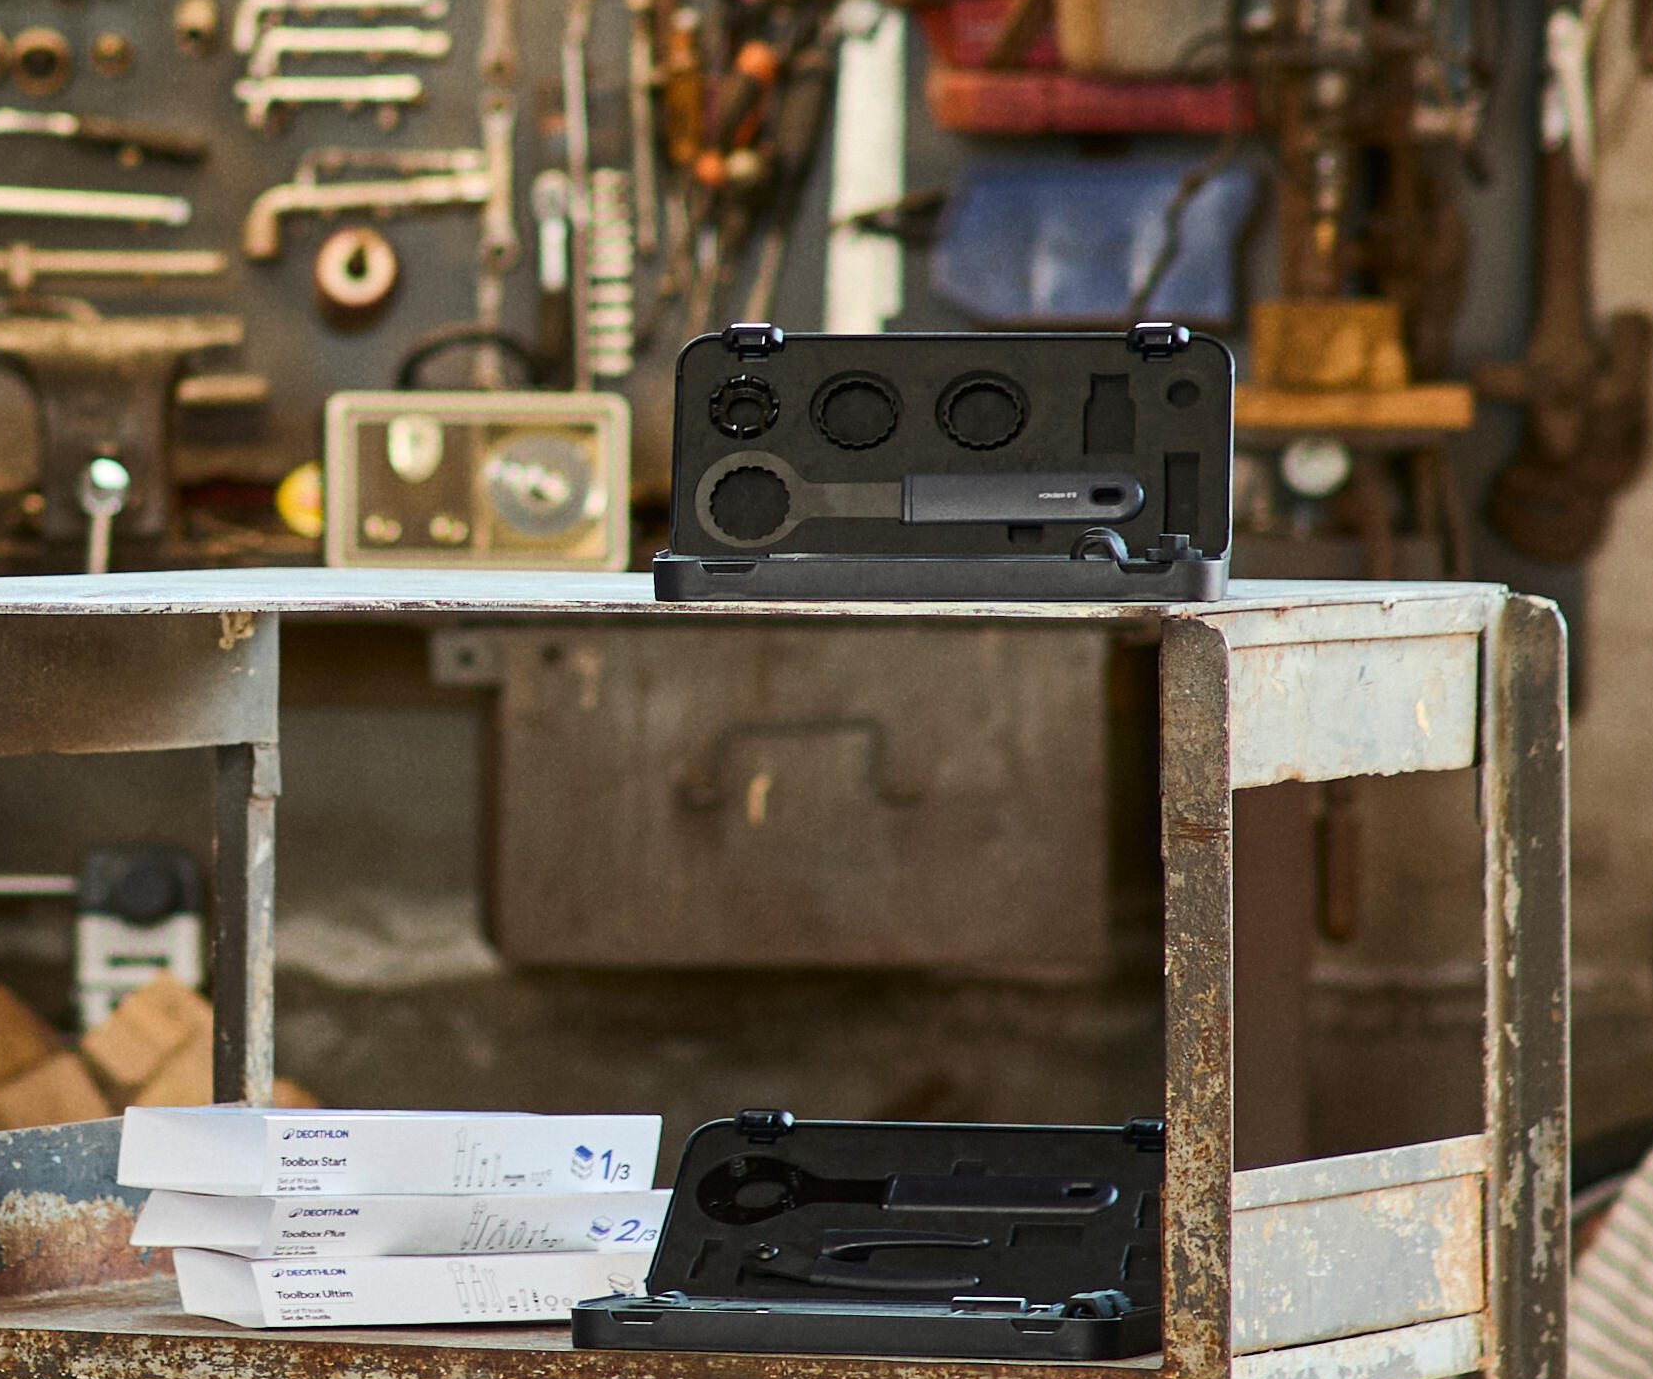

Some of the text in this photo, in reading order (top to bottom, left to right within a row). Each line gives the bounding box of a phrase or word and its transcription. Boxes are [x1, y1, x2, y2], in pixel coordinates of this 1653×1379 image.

[295, 1129, 349, 1139] DECATHLON
[281, 1156, 347, 1167] Toolbox Start
[600, 1148, 631, 1183] 1/3
[302, 1207, 360, 1217] DECATHLON
[282, 1229, 346, 1238] Toolbox Plus
[613, 1219, 658, 1244] 2/3
[286, 1268, 346, 1277] DECATHLON
[276, 1289, 354, 1300] Toolbox Ultim
